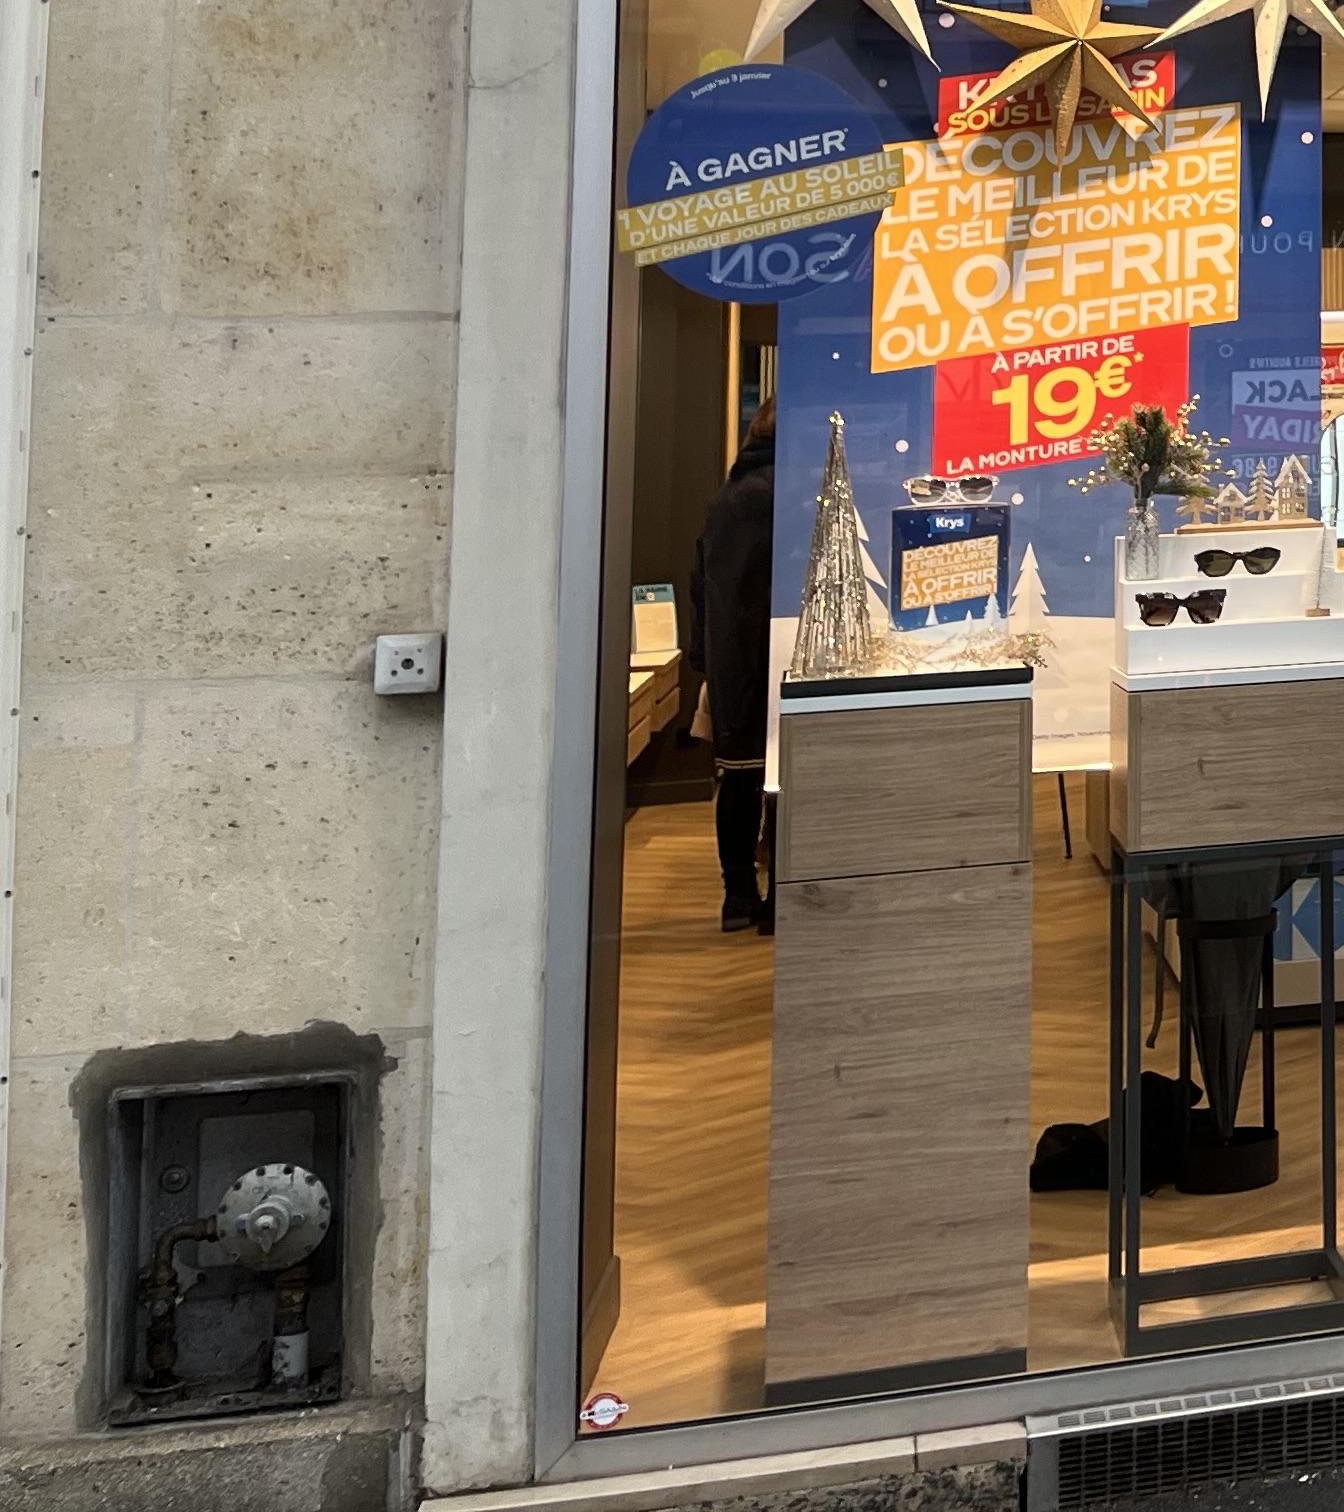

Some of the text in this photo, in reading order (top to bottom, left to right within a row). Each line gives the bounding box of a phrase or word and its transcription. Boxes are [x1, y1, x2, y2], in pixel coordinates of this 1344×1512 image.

[948, 104, 1029, 133] SOUS
[637, 187, 752, 226] VOYAGE
[760, 175, 798, 199] AU
[805, 153, 900, 186] SOLEIL
[665, 161, 692, 190] À
[884, 151, 1236, 225] LE MEILLEUR DE
[630, 218, 700, 247] D'UNE
[703, 196, 791, 230] VALEUR
[796, 191, 824, 210] DE
[637, 195, 893, 265] ET CHAQUE JOUR DES CADEAUX
[882, 229, 930, 260] LA
[936, 202, 1135, 251] SÉLECTION
[1143, 188, 1236, 223] KRYS
[881, 251, 942, 322] À
[952, 223, 1236, 311] OFFRIR
[879, 319, 950, 363] OU
[958, 306, 995, 353] À
[991, 335, 1135, 374] À PARTIR DE
[947, 456, 975, 475] LA
[978, 439, 1084, 470] MONTURE
[936, 517, 964, 529] Krys
[903, 549, 997, 573] LE MEILLEUR DE
[922, 568, 997, 594] OFFRIR
